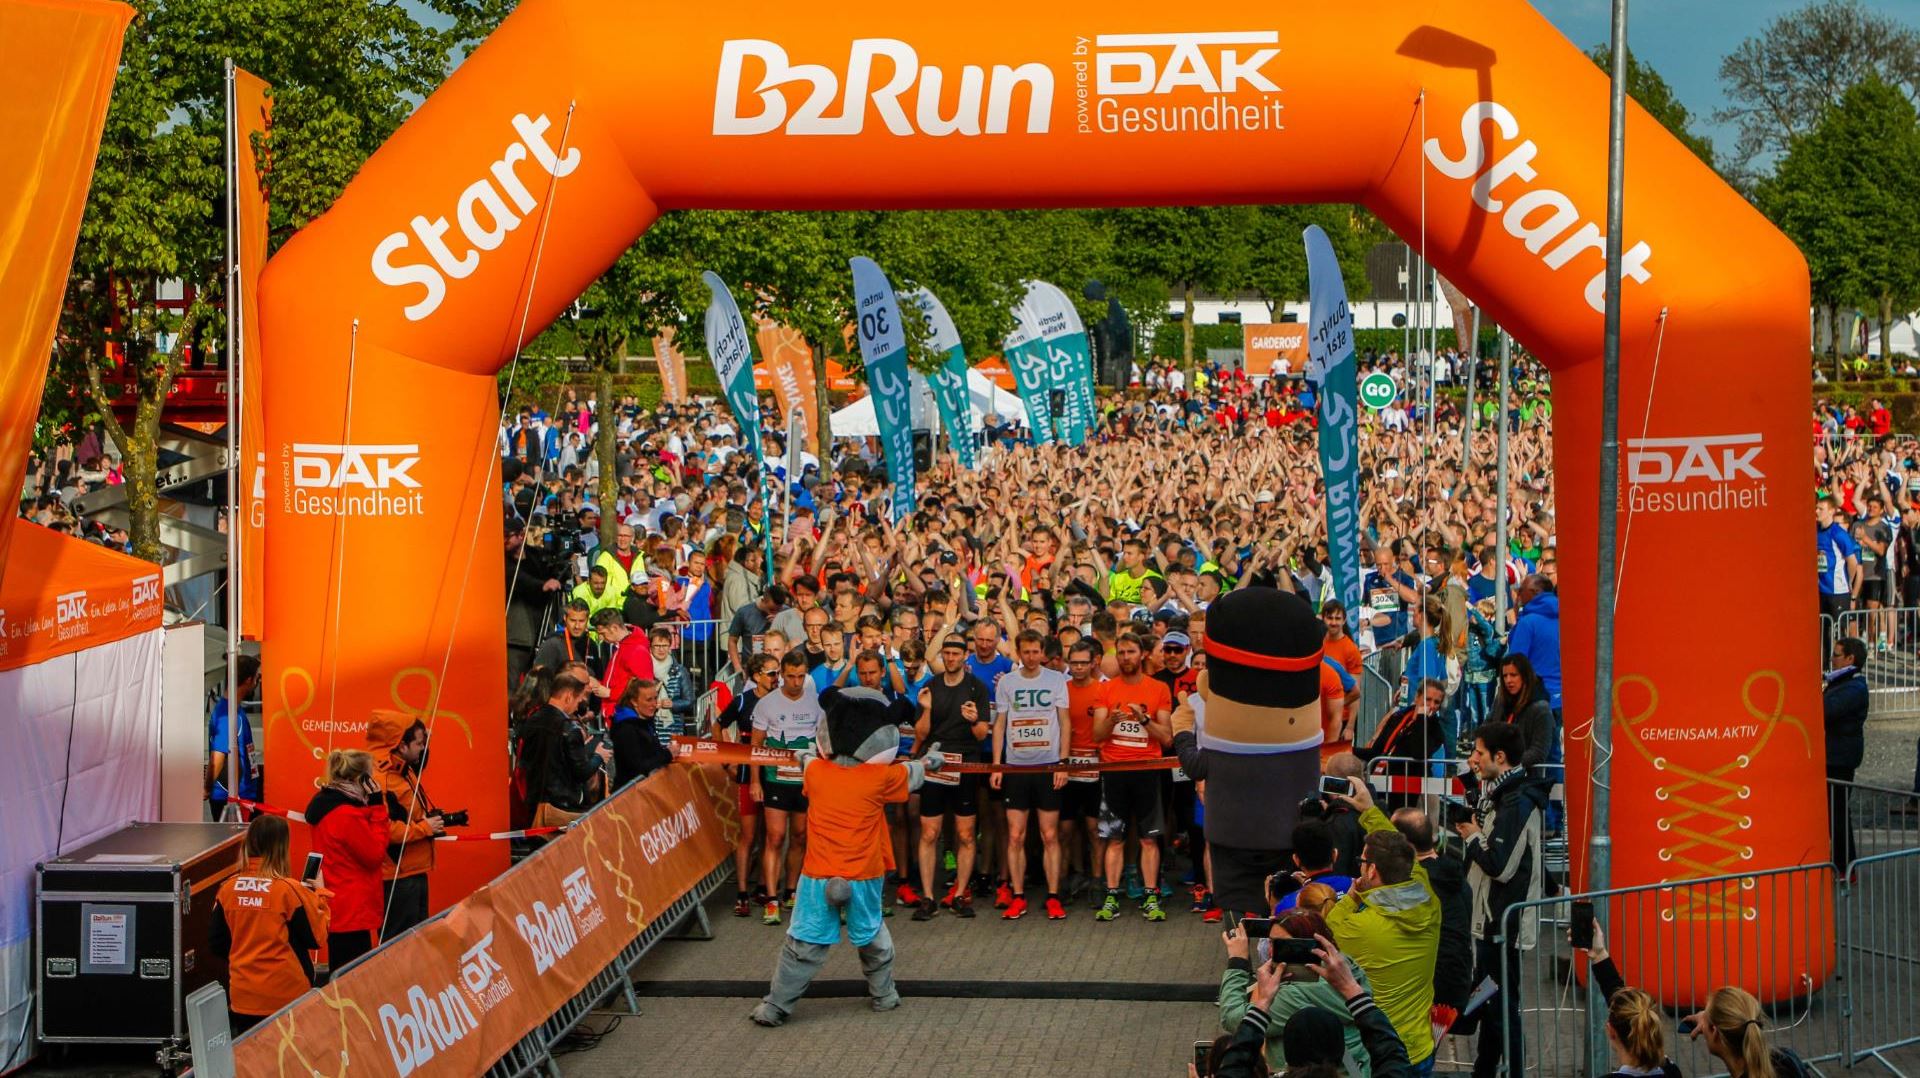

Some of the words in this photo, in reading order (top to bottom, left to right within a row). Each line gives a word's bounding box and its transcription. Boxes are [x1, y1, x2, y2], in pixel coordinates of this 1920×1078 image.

[1072, 36, 1091, 56] by
[1096, 31, 1283, 95] DAK
[713, 38, 1055, 136] B2Run
[1072, 61, 1092, 134] powered
[1097, 95, 1285, 133] Gesundheit
[371, 113, 581, 321] Start
[1424, 101, 1652, 314] Start
[1366, 383, 1391, 397] GO
[281, 443, 290, 458] by
[293, 443, 424, 488] DAK
[1627, 433, 1767, 483] DAK
[156, 473, 188, 488] et...
[281, 461, 290, 513] powered
[294, 488, 424, 516] Gesundheit
[1628, 481, 1768, 513] Gesundheit
[132, 573, 160, 605] DAK
[57, 590, 87, 624] DAK
[1014, 690, 1052, 708] ETC
[302, 719, 369, 733] GEMEINSAM
[1017, 728, 1043, 738] 1540
[1119, 722, 1140, 733] 535
[234, 876, 273, 893] DAK
[237, 896, 263, 907] TEAM
[378, 984, 479, 1078] B2Run
